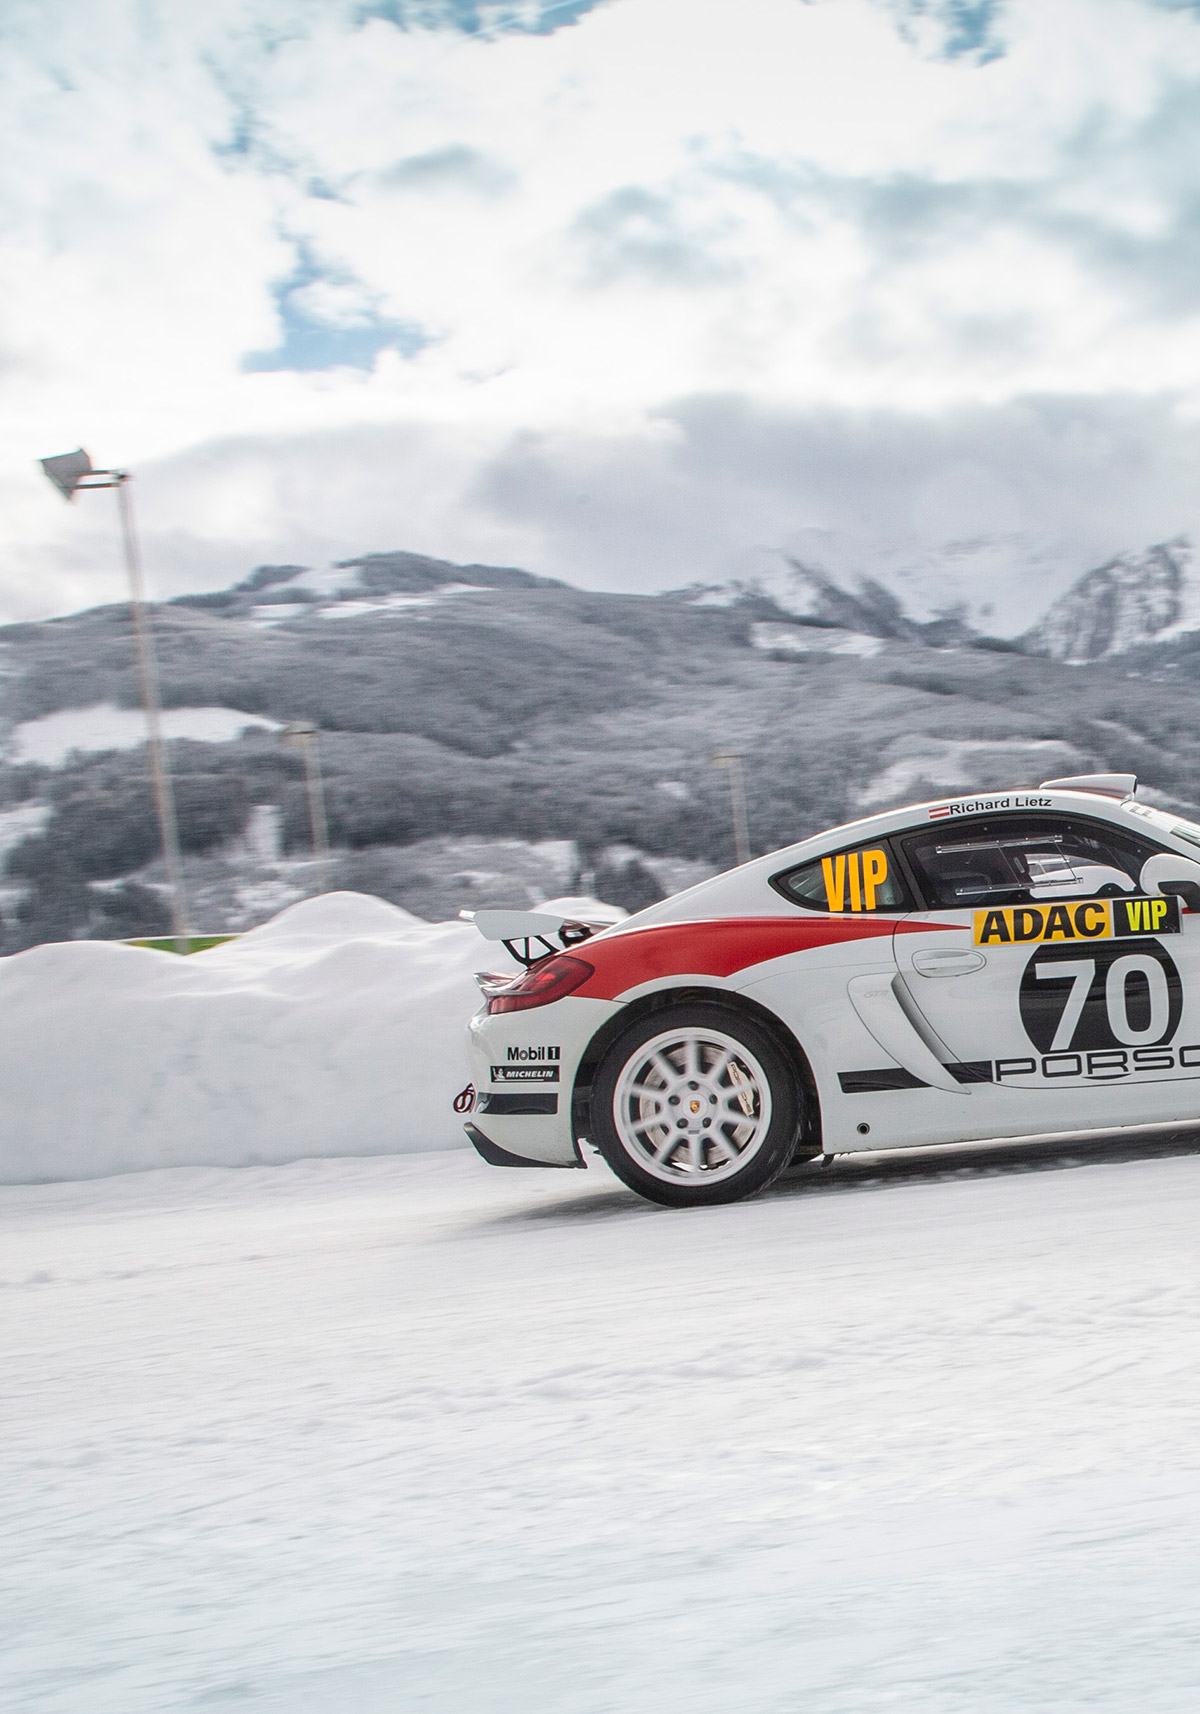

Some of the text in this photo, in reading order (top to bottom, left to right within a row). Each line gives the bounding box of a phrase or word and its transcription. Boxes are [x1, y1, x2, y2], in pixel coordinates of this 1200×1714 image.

[949, 797, 1052, 815] Richard Lietz
[821, 849, 888, 912] VIP
[979, 900, 1168, 944] ADAC VIP
[1035, 954, 1169, 1052] 70
[507, 1046, 560, 1060] Mobil 1
